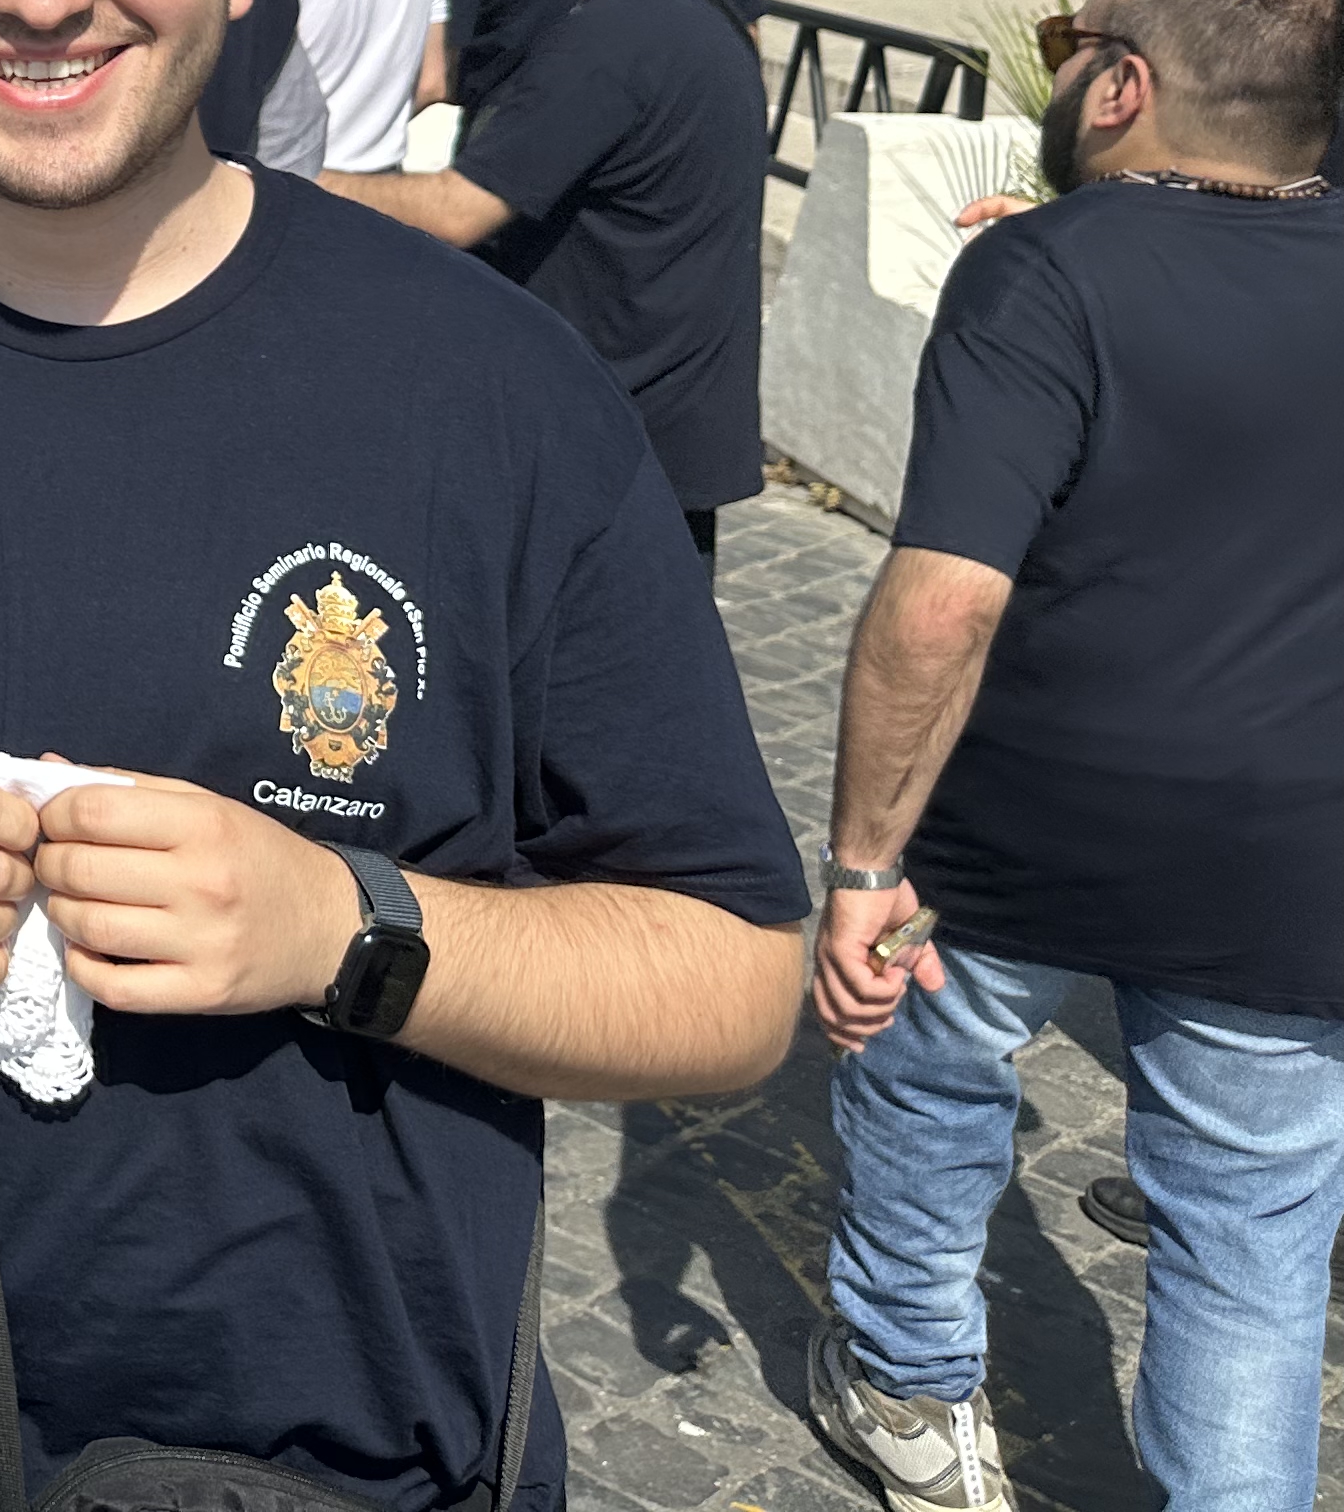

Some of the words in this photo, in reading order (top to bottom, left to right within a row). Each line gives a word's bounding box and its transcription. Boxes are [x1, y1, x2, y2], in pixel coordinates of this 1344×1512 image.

[223, 591, 263, 669] Pontificio
[252, 542, 326, 594] Seminario
[329, 542, 406, 601] Regionale
[416, 646, 427, 676] Pio
[252, 780, 386, 819] Catanzaro
